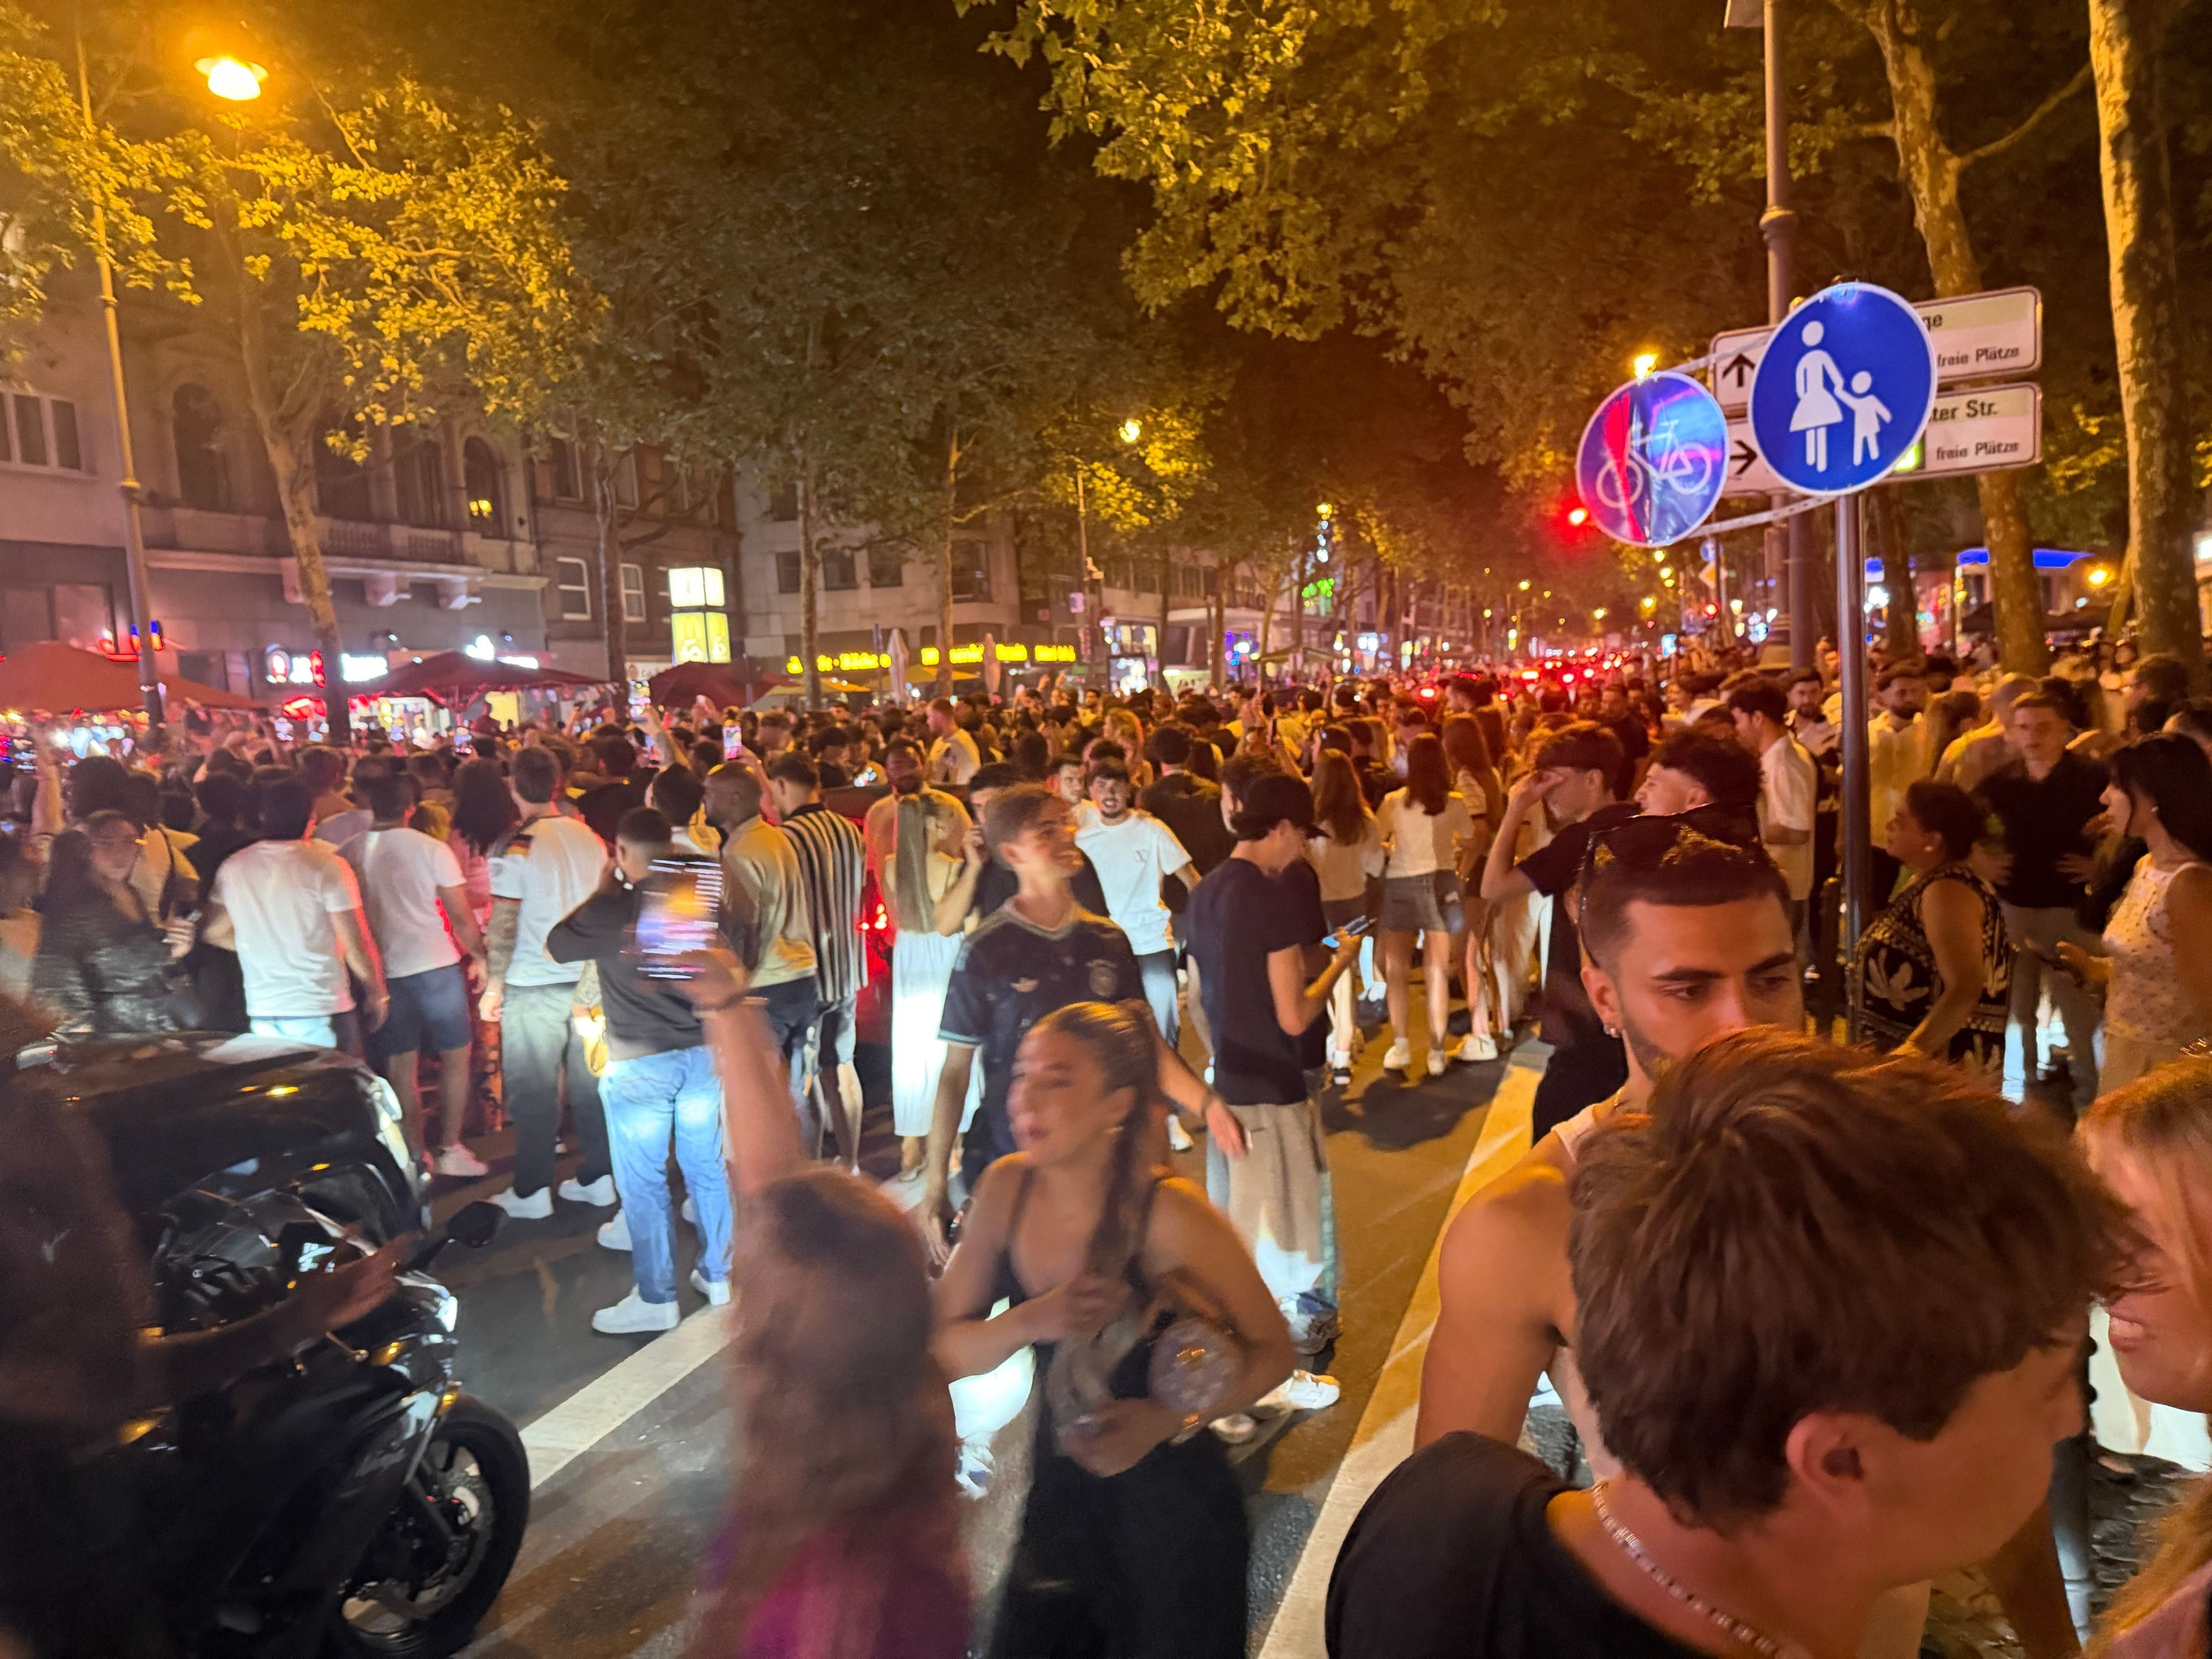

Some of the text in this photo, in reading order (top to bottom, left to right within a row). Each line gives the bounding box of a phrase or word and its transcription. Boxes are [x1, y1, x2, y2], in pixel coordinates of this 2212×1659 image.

[1922, 315, 1942, 332] ge
[1937, 347, 2019, 367] freie Plätze
[1929, 399, 1999, 422] ter Str.
[1937, 441, 2019, 460] freie Plätze
